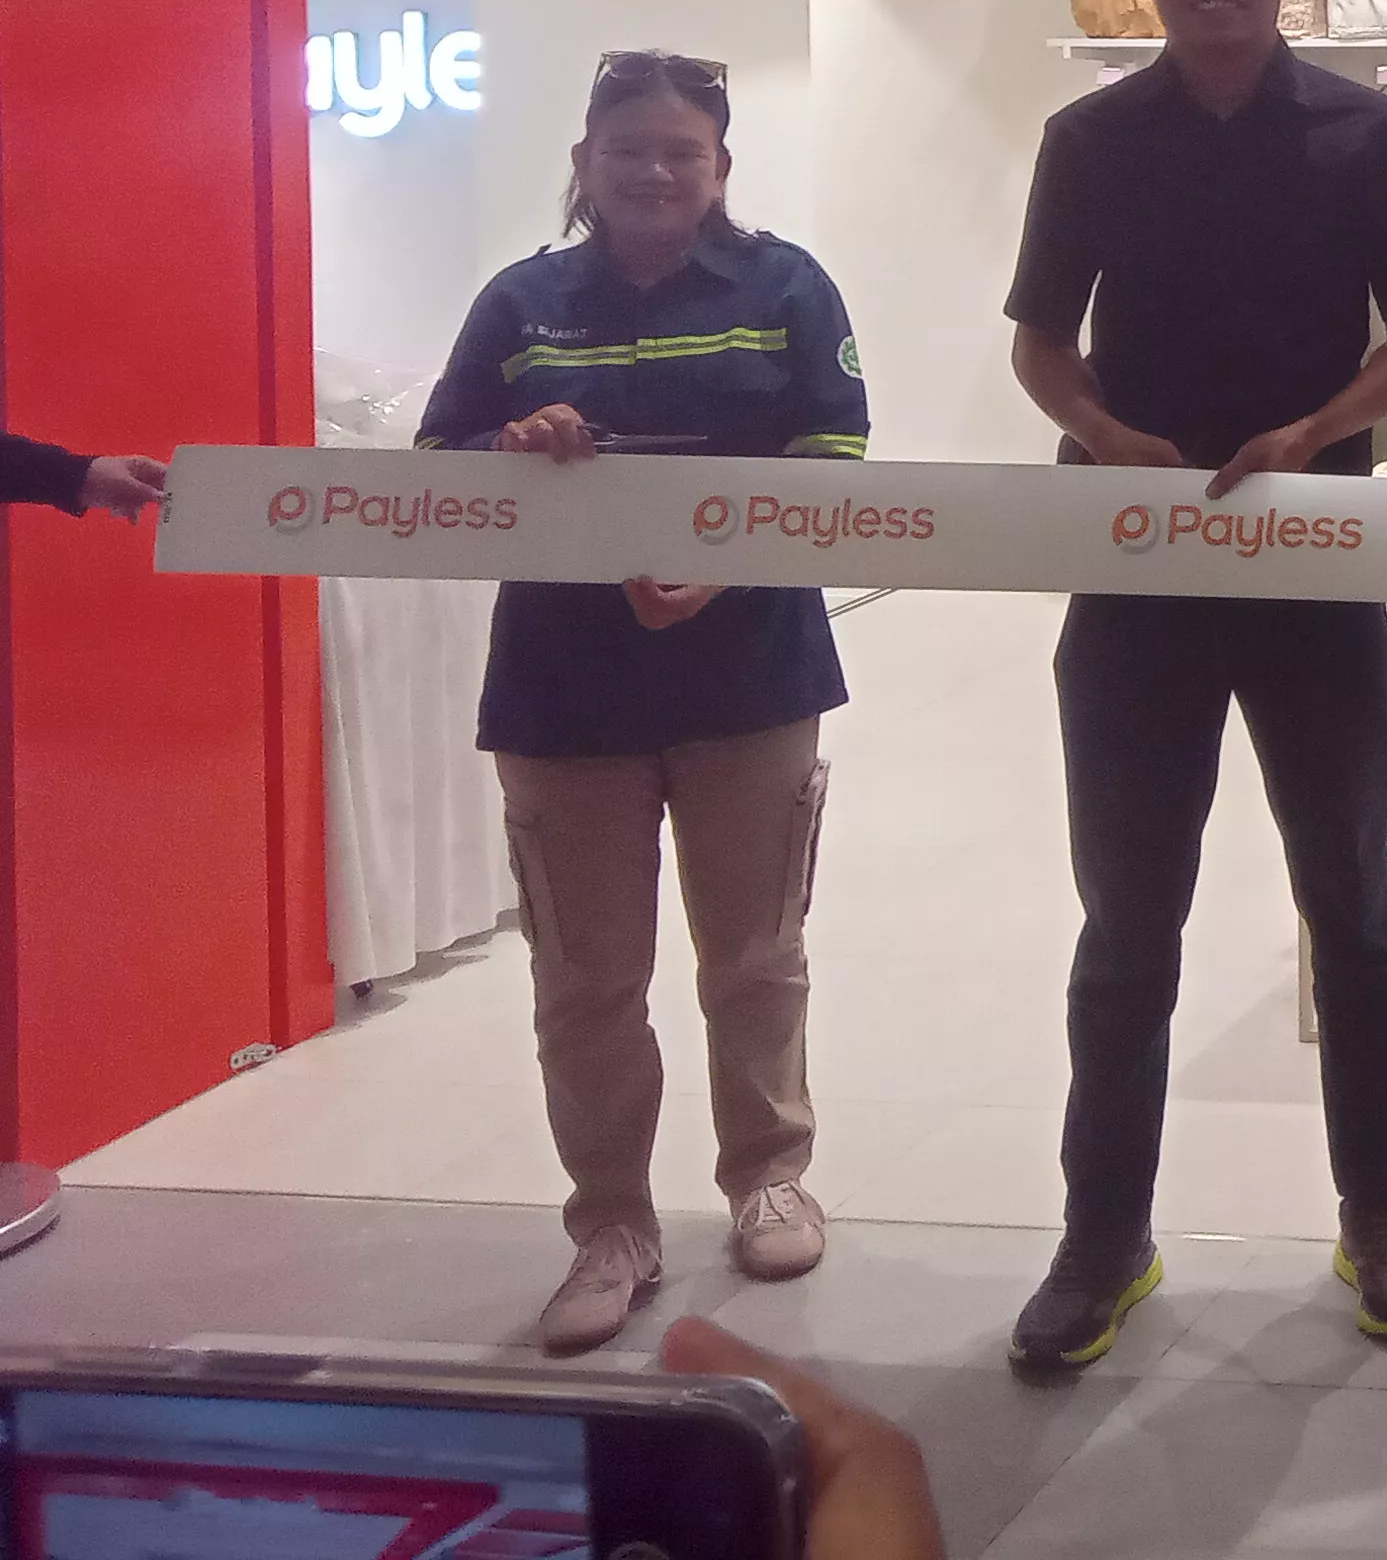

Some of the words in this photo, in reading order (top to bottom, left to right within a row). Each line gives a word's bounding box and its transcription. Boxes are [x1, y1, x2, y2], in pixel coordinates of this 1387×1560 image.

[321, 484, 520, 539] Payless
[745, 493, 936, 549] Payless
[1165, 503, 1364, 560] Payless
